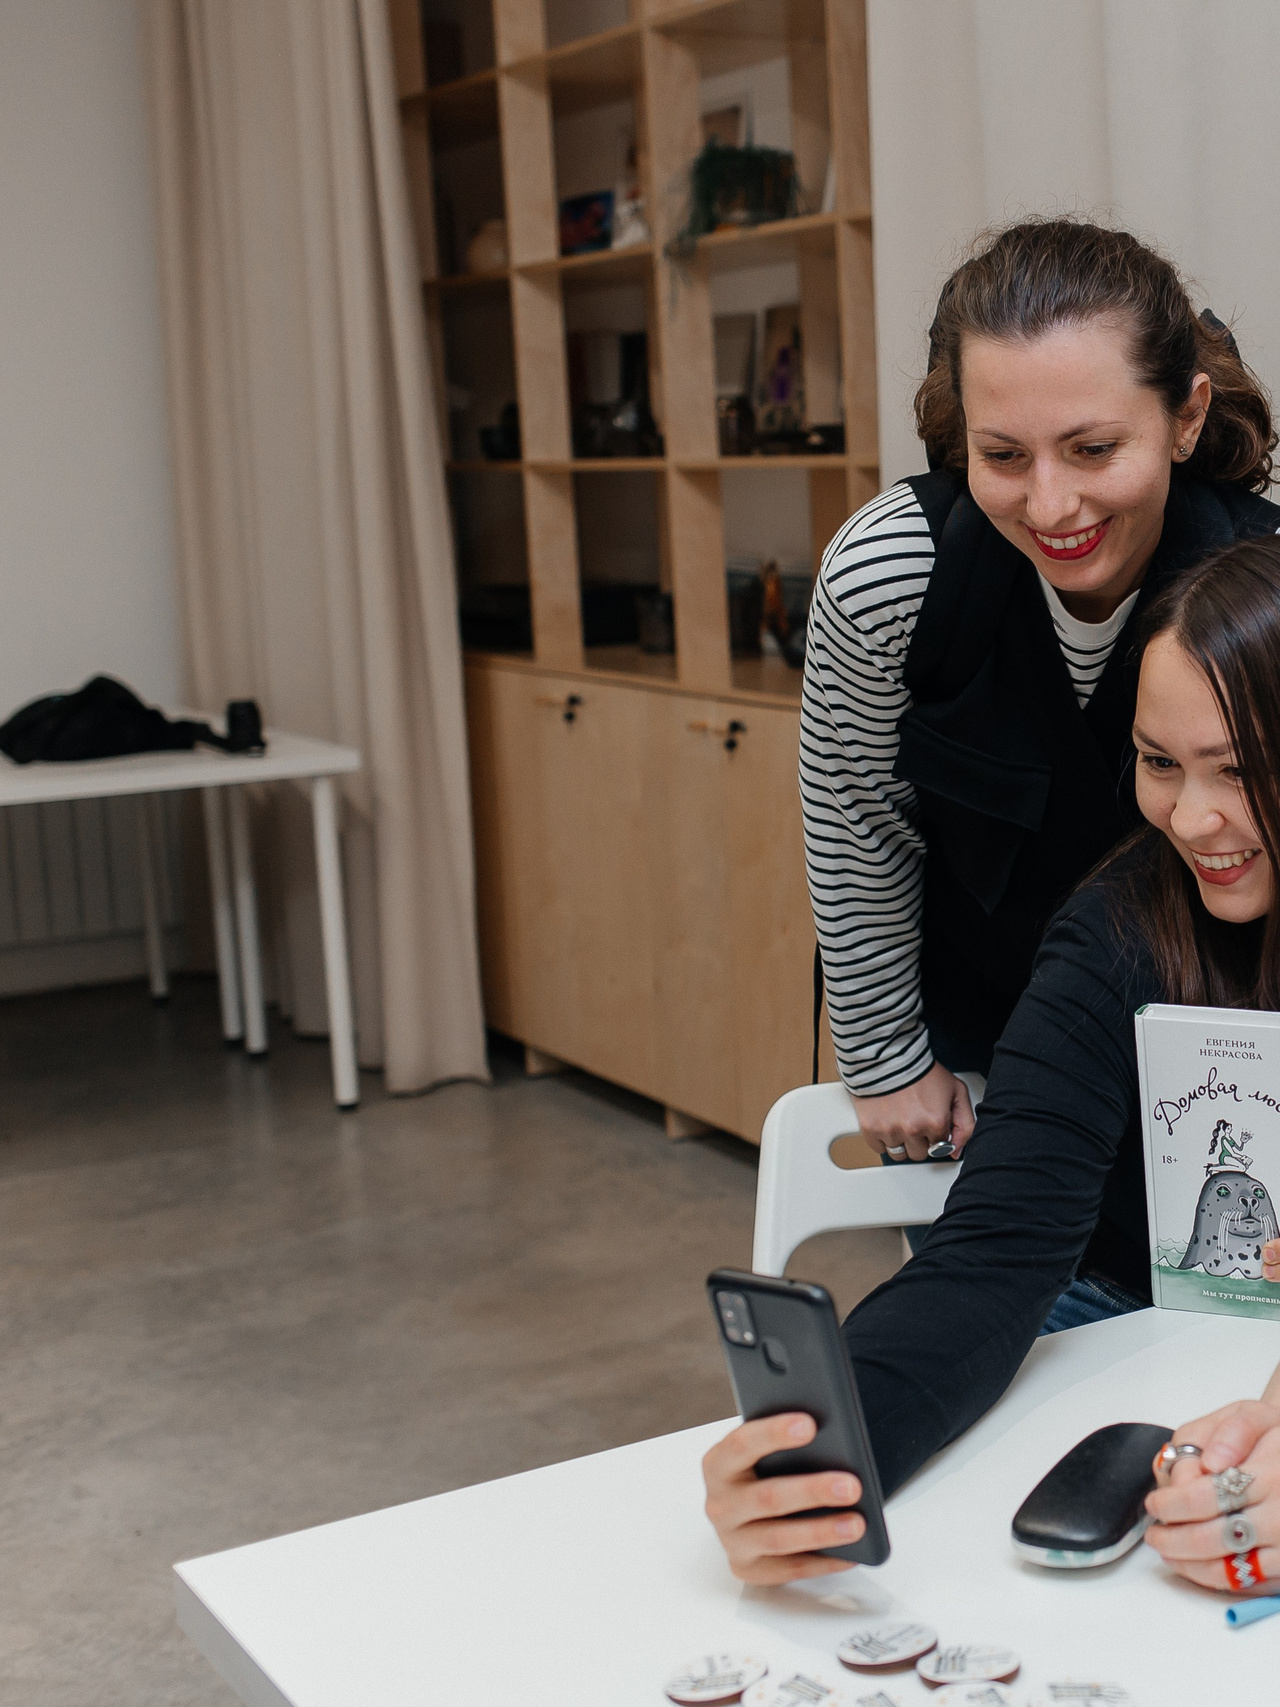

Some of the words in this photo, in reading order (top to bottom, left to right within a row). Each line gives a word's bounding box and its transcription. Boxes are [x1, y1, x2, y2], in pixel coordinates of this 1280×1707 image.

[1206, 1038, 1256, 1049] ЕВГЕНИЯ
[1200, 1049, 1263, 1061] НЕКРАСОВА
[1154, 1066, 1243, 1136] Домовая
[1161, 1155, 1178, 1164] 18+
[1202, 1289, 1217, 1297] Мы
[1219, 1291, 1234, 1300] тут
